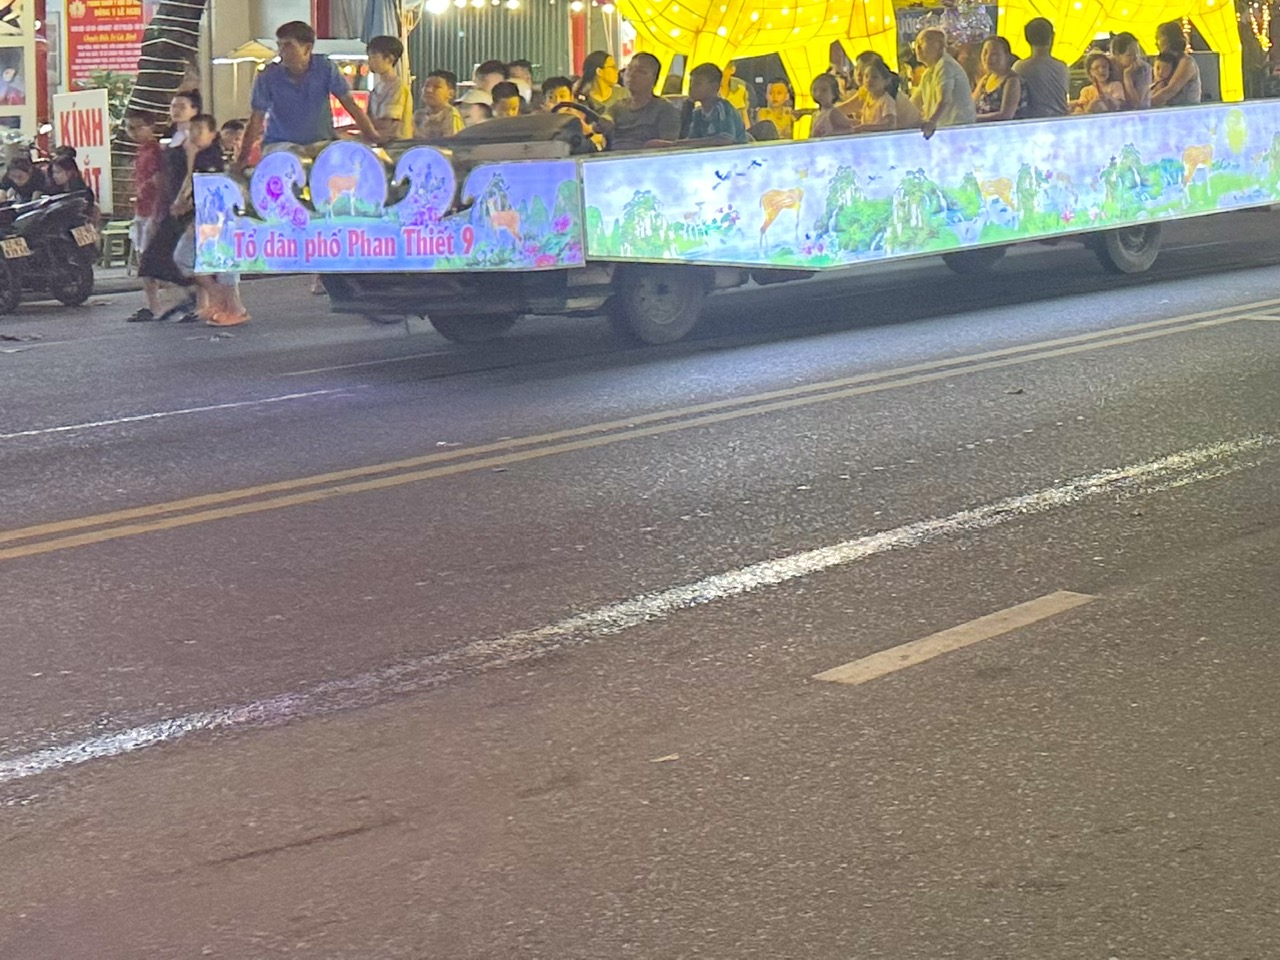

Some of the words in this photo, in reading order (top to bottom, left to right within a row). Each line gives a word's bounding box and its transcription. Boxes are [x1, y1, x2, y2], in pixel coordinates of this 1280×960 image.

[60, 102, 104, 147] KÍNH
[234, 228, 257, 258] Tổ
[264, 230, 297, 258] dân
[305, 228, 342, 263] phố
[348, 229, 396, 257] Phan
[402, 225, 454, 257] Thiết
[461, 226, 474, 255] 9
